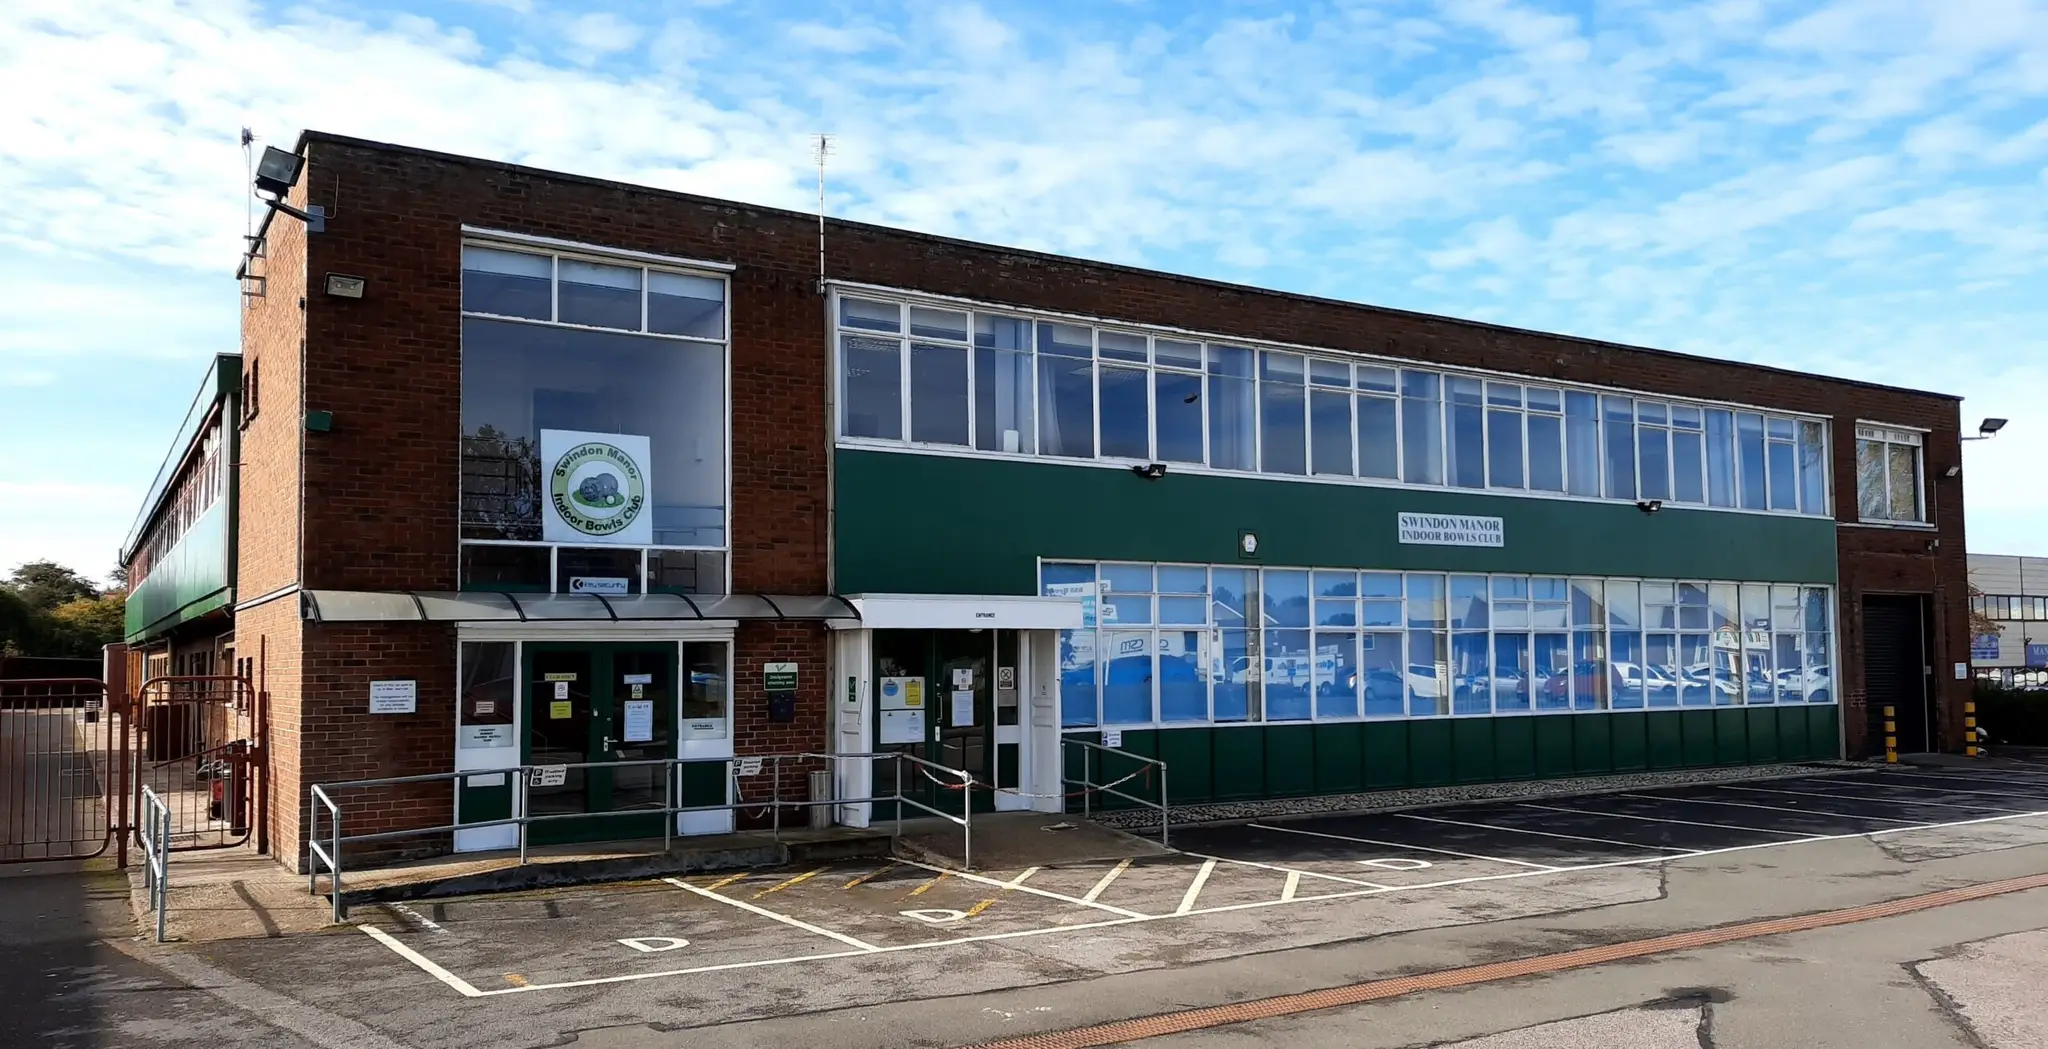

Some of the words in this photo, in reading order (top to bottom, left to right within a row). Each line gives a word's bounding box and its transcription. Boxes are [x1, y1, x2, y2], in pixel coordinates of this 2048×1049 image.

[556, 447, 603, 477] Swindon
[607, 448, 638, 480] Manor
[554, 493, 583, 526] Indoor
[585, 519, 623, 531] Bowls
[623, 495, 641, 520] Club
[1401, 516, 1457, 529] SWINDON
[1459, 519, 1500, 531] MANOR
[1402, 530, 1441, 541] INDOOR
[1443, 532, 1477, 542] BOWLS
[1478, 534, 1501, 543] CLUB
[1356, 858, 1432, 870] D
[900, 909, 968, 923] D
[617, 937, 690, 951] D
